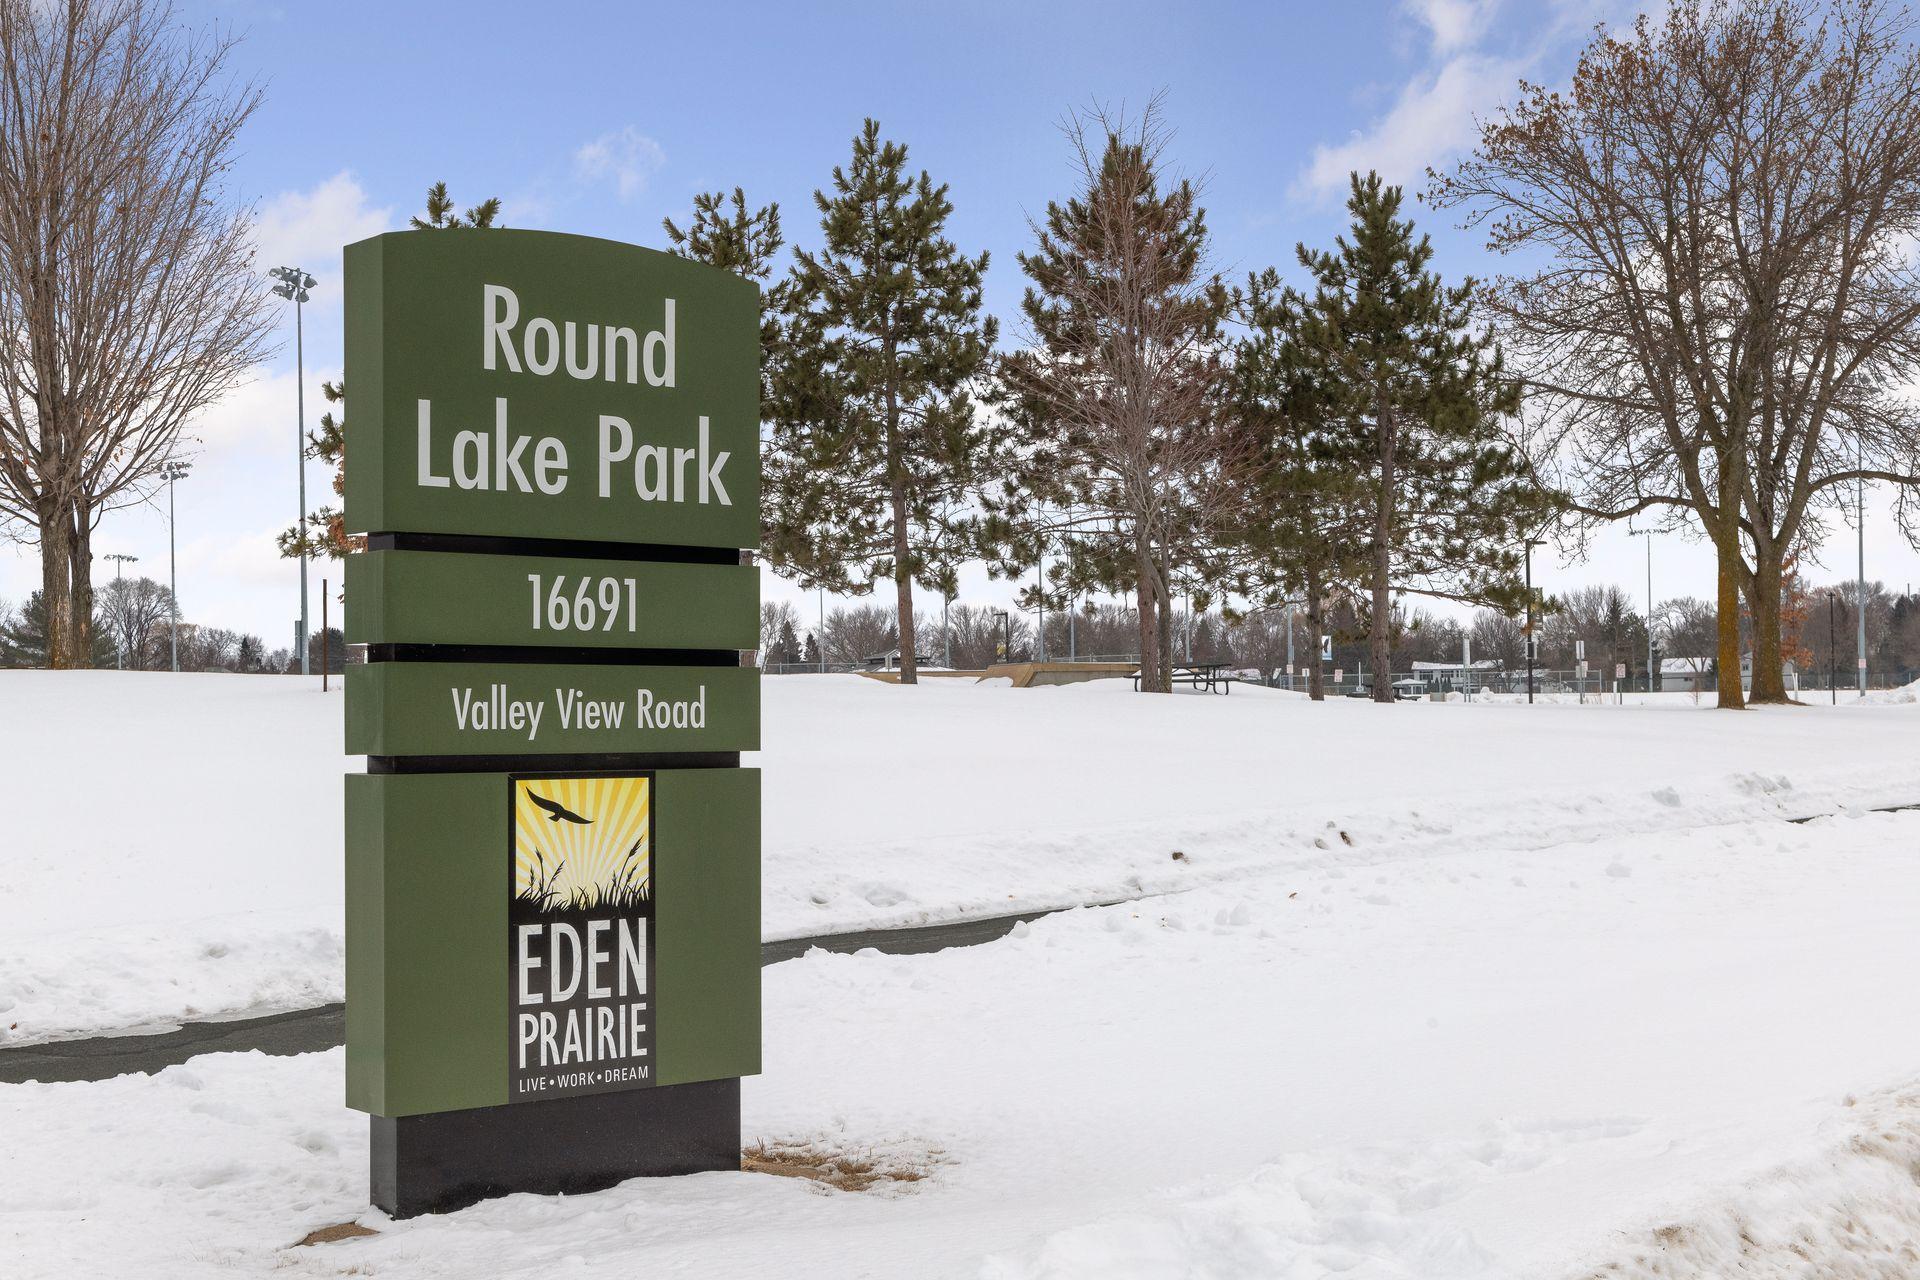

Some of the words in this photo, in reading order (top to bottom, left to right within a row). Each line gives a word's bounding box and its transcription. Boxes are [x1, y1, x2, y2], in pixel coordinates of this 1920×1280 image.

[483, 283, 676, 388] Round
[417, 398, 569, 495] Lake
[598, 414, 733, 506] Park
[527, 573, 637, 632] 16691
[451, 683, 545, 741] Valley
[555, 688, 625, 730] View
[637, 685, 706, 729] Road
[518, 917, 647, 1006] EDEN
[518, 1002, 648, 1069] PRAIRIE
